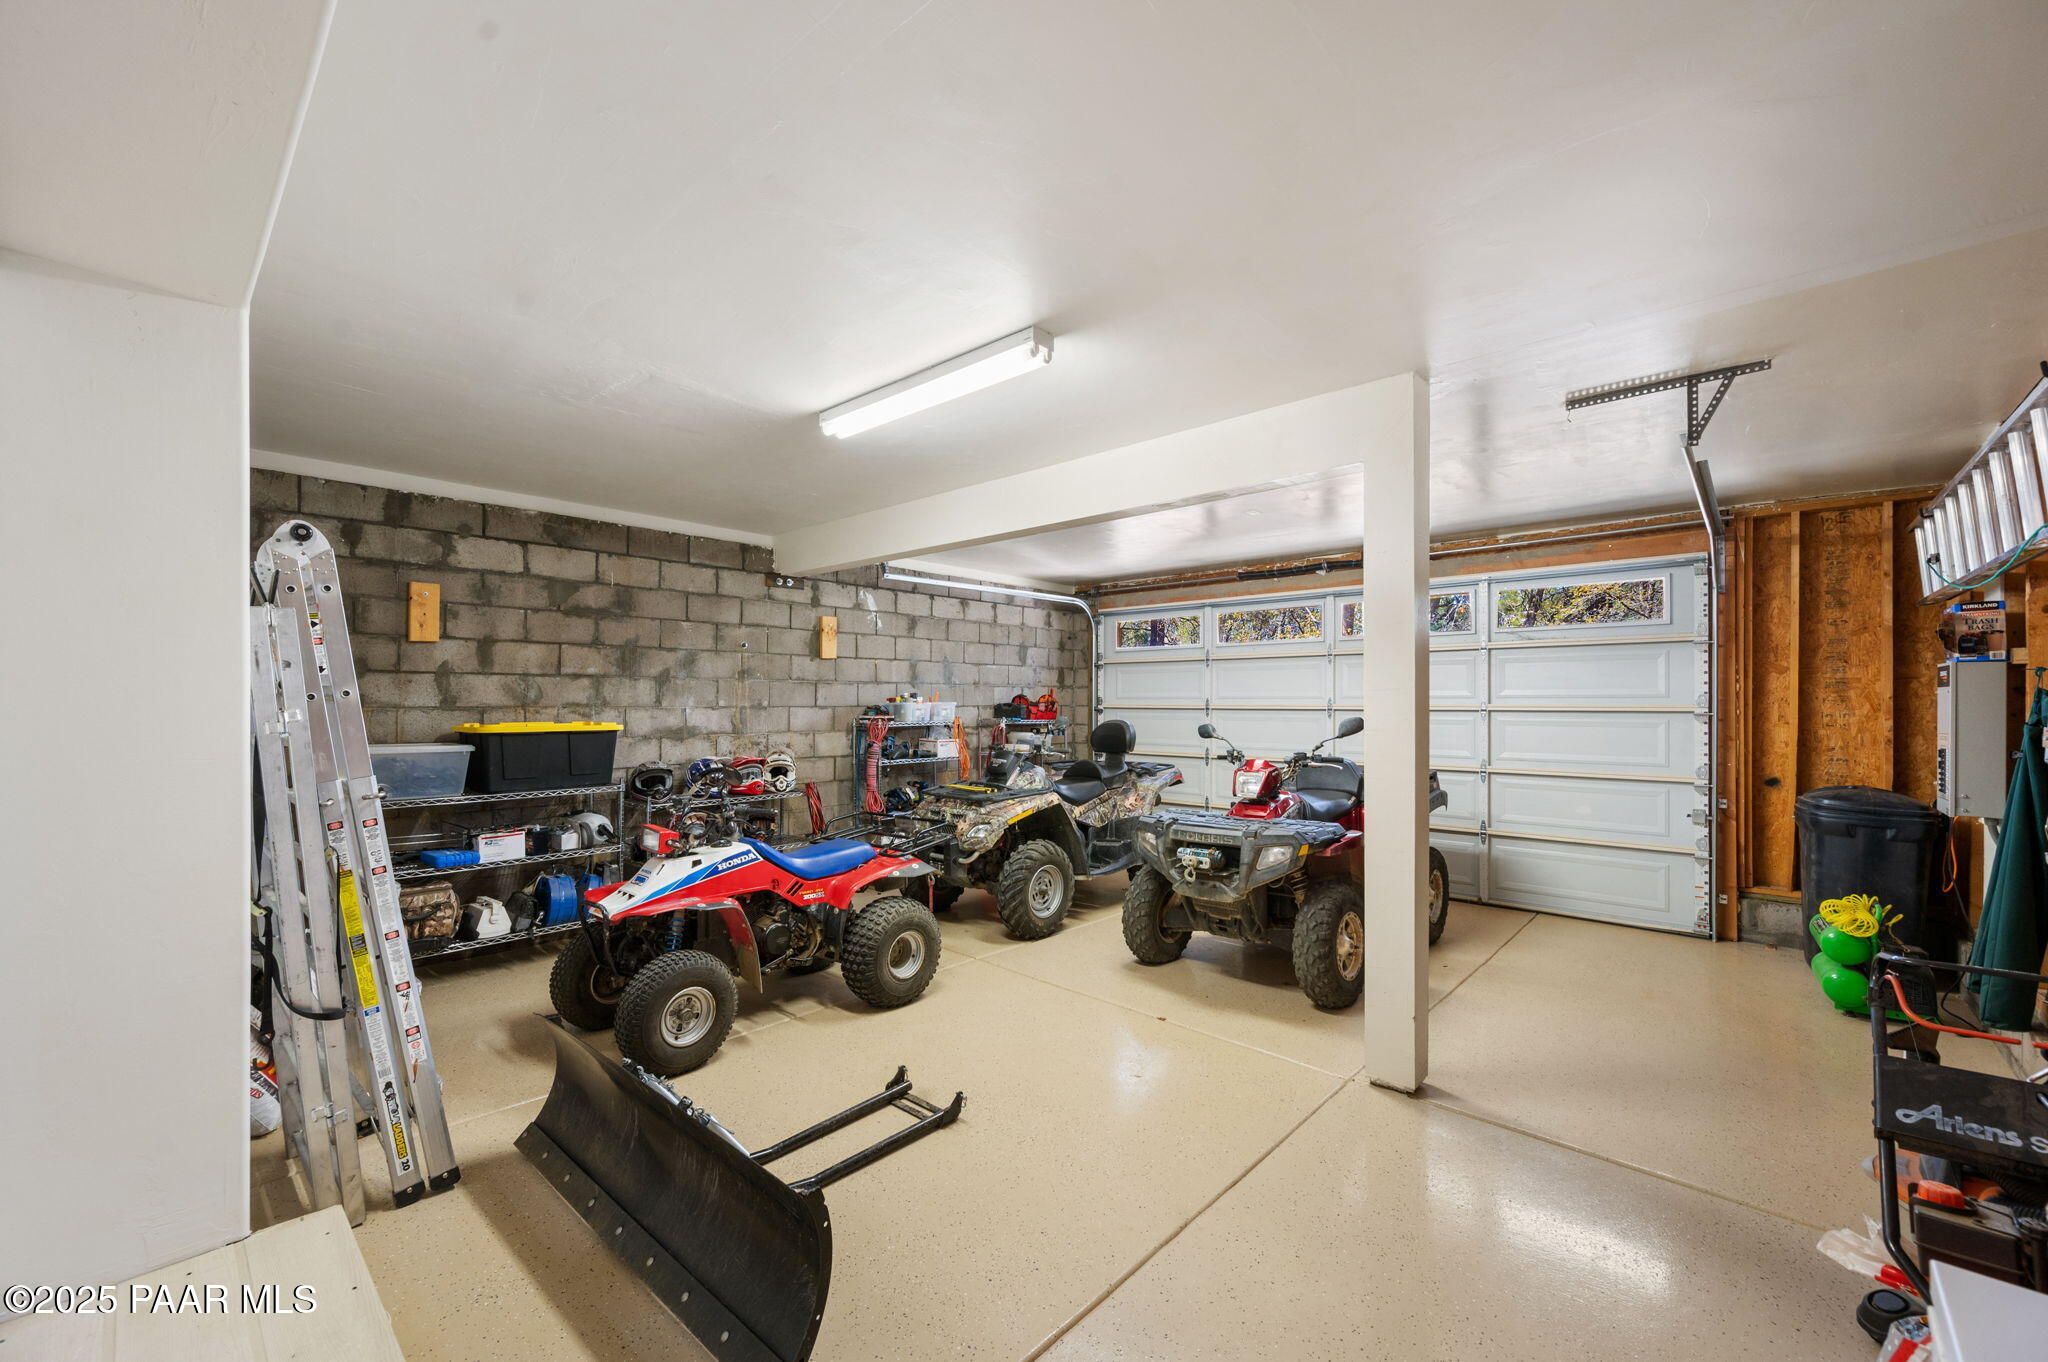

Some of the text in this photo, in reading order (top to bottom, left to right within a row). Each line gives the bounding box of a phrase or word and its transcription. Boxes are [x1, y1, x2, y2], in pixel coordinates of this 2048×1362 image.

[1964, 617, 1999, 625] TRASH
[1178, 830, 1233, 844] POLARIS
[717, 852, 757, 871] HONDA
[1895, 1104, 2023, 1147] Ariens
[391, 1121, 408, 1160] LADDERS
[401, 1158, 411, 1172] 20
